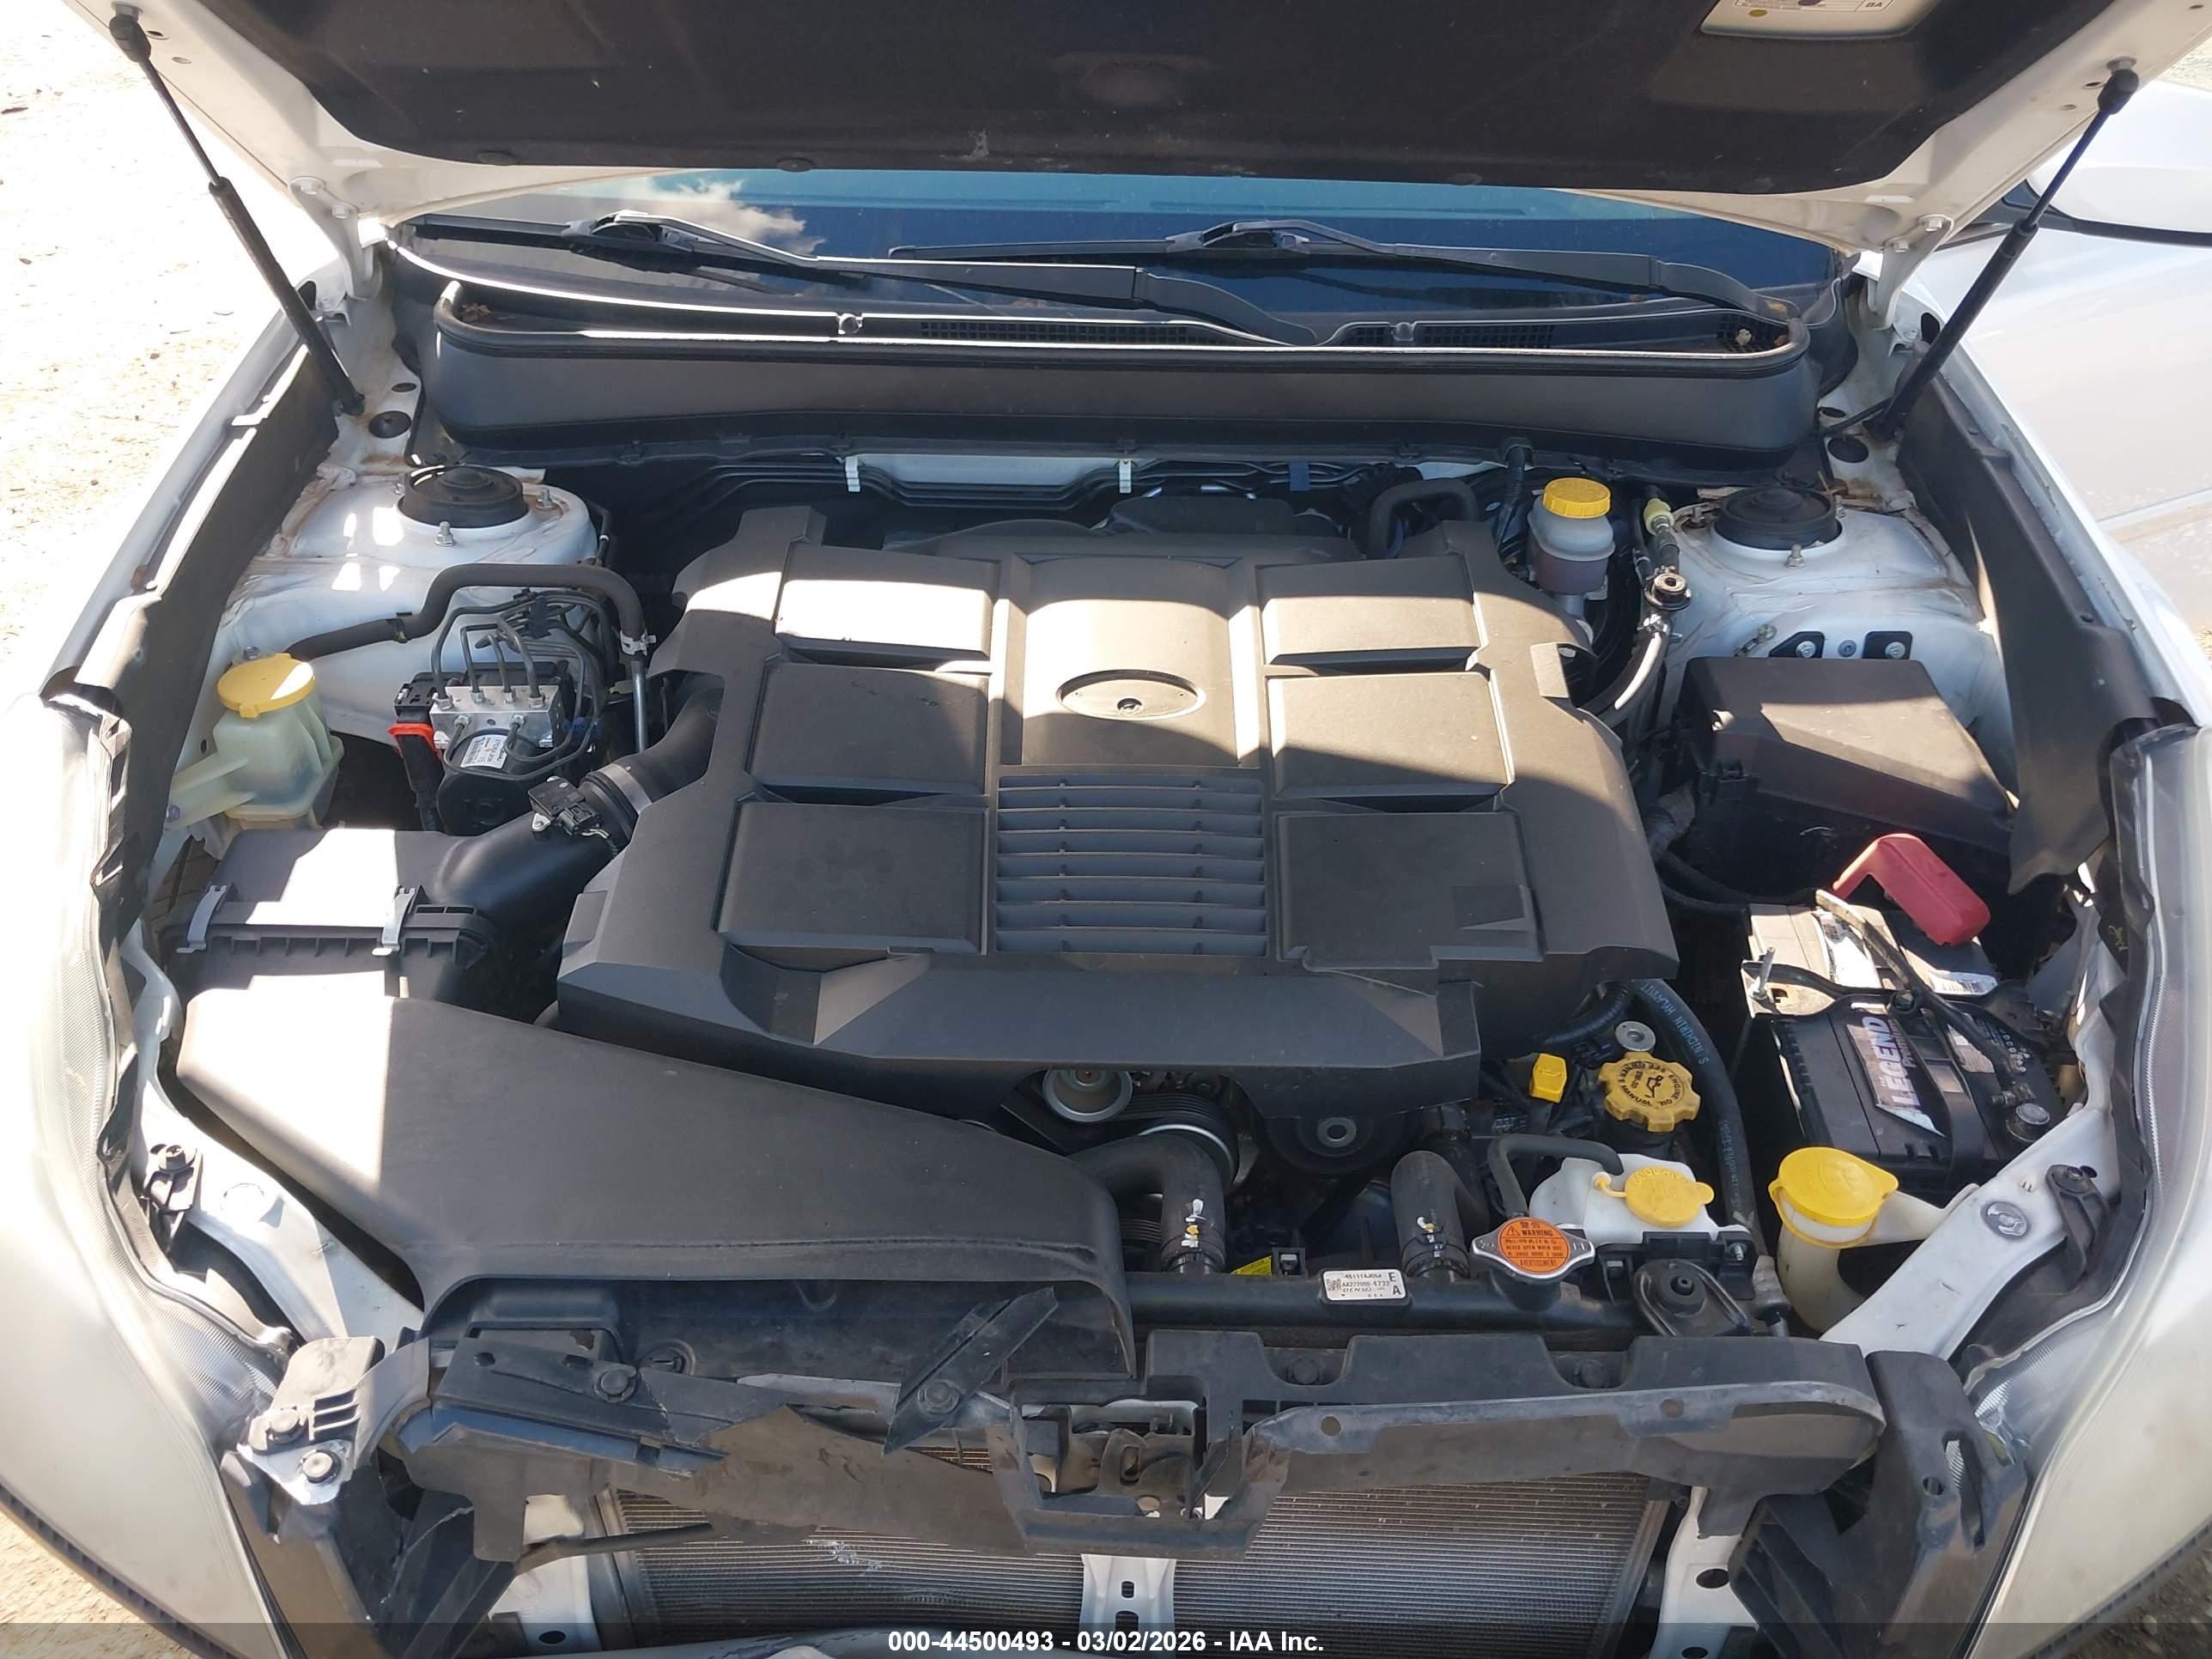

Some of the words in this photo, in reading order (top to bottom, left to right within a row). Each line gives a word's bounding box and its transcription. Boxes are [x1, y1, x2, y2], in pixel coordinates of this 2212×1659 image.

[1862, 1016, 1921, 1106] LEGEND
[1620, 1085, 1653, 1106] MANUAL
[1521, 1229, 1553, 1237] WARNING
[1388, 1272, 1396, 1282] E
[1392, 1285, 1401, 1295] A
